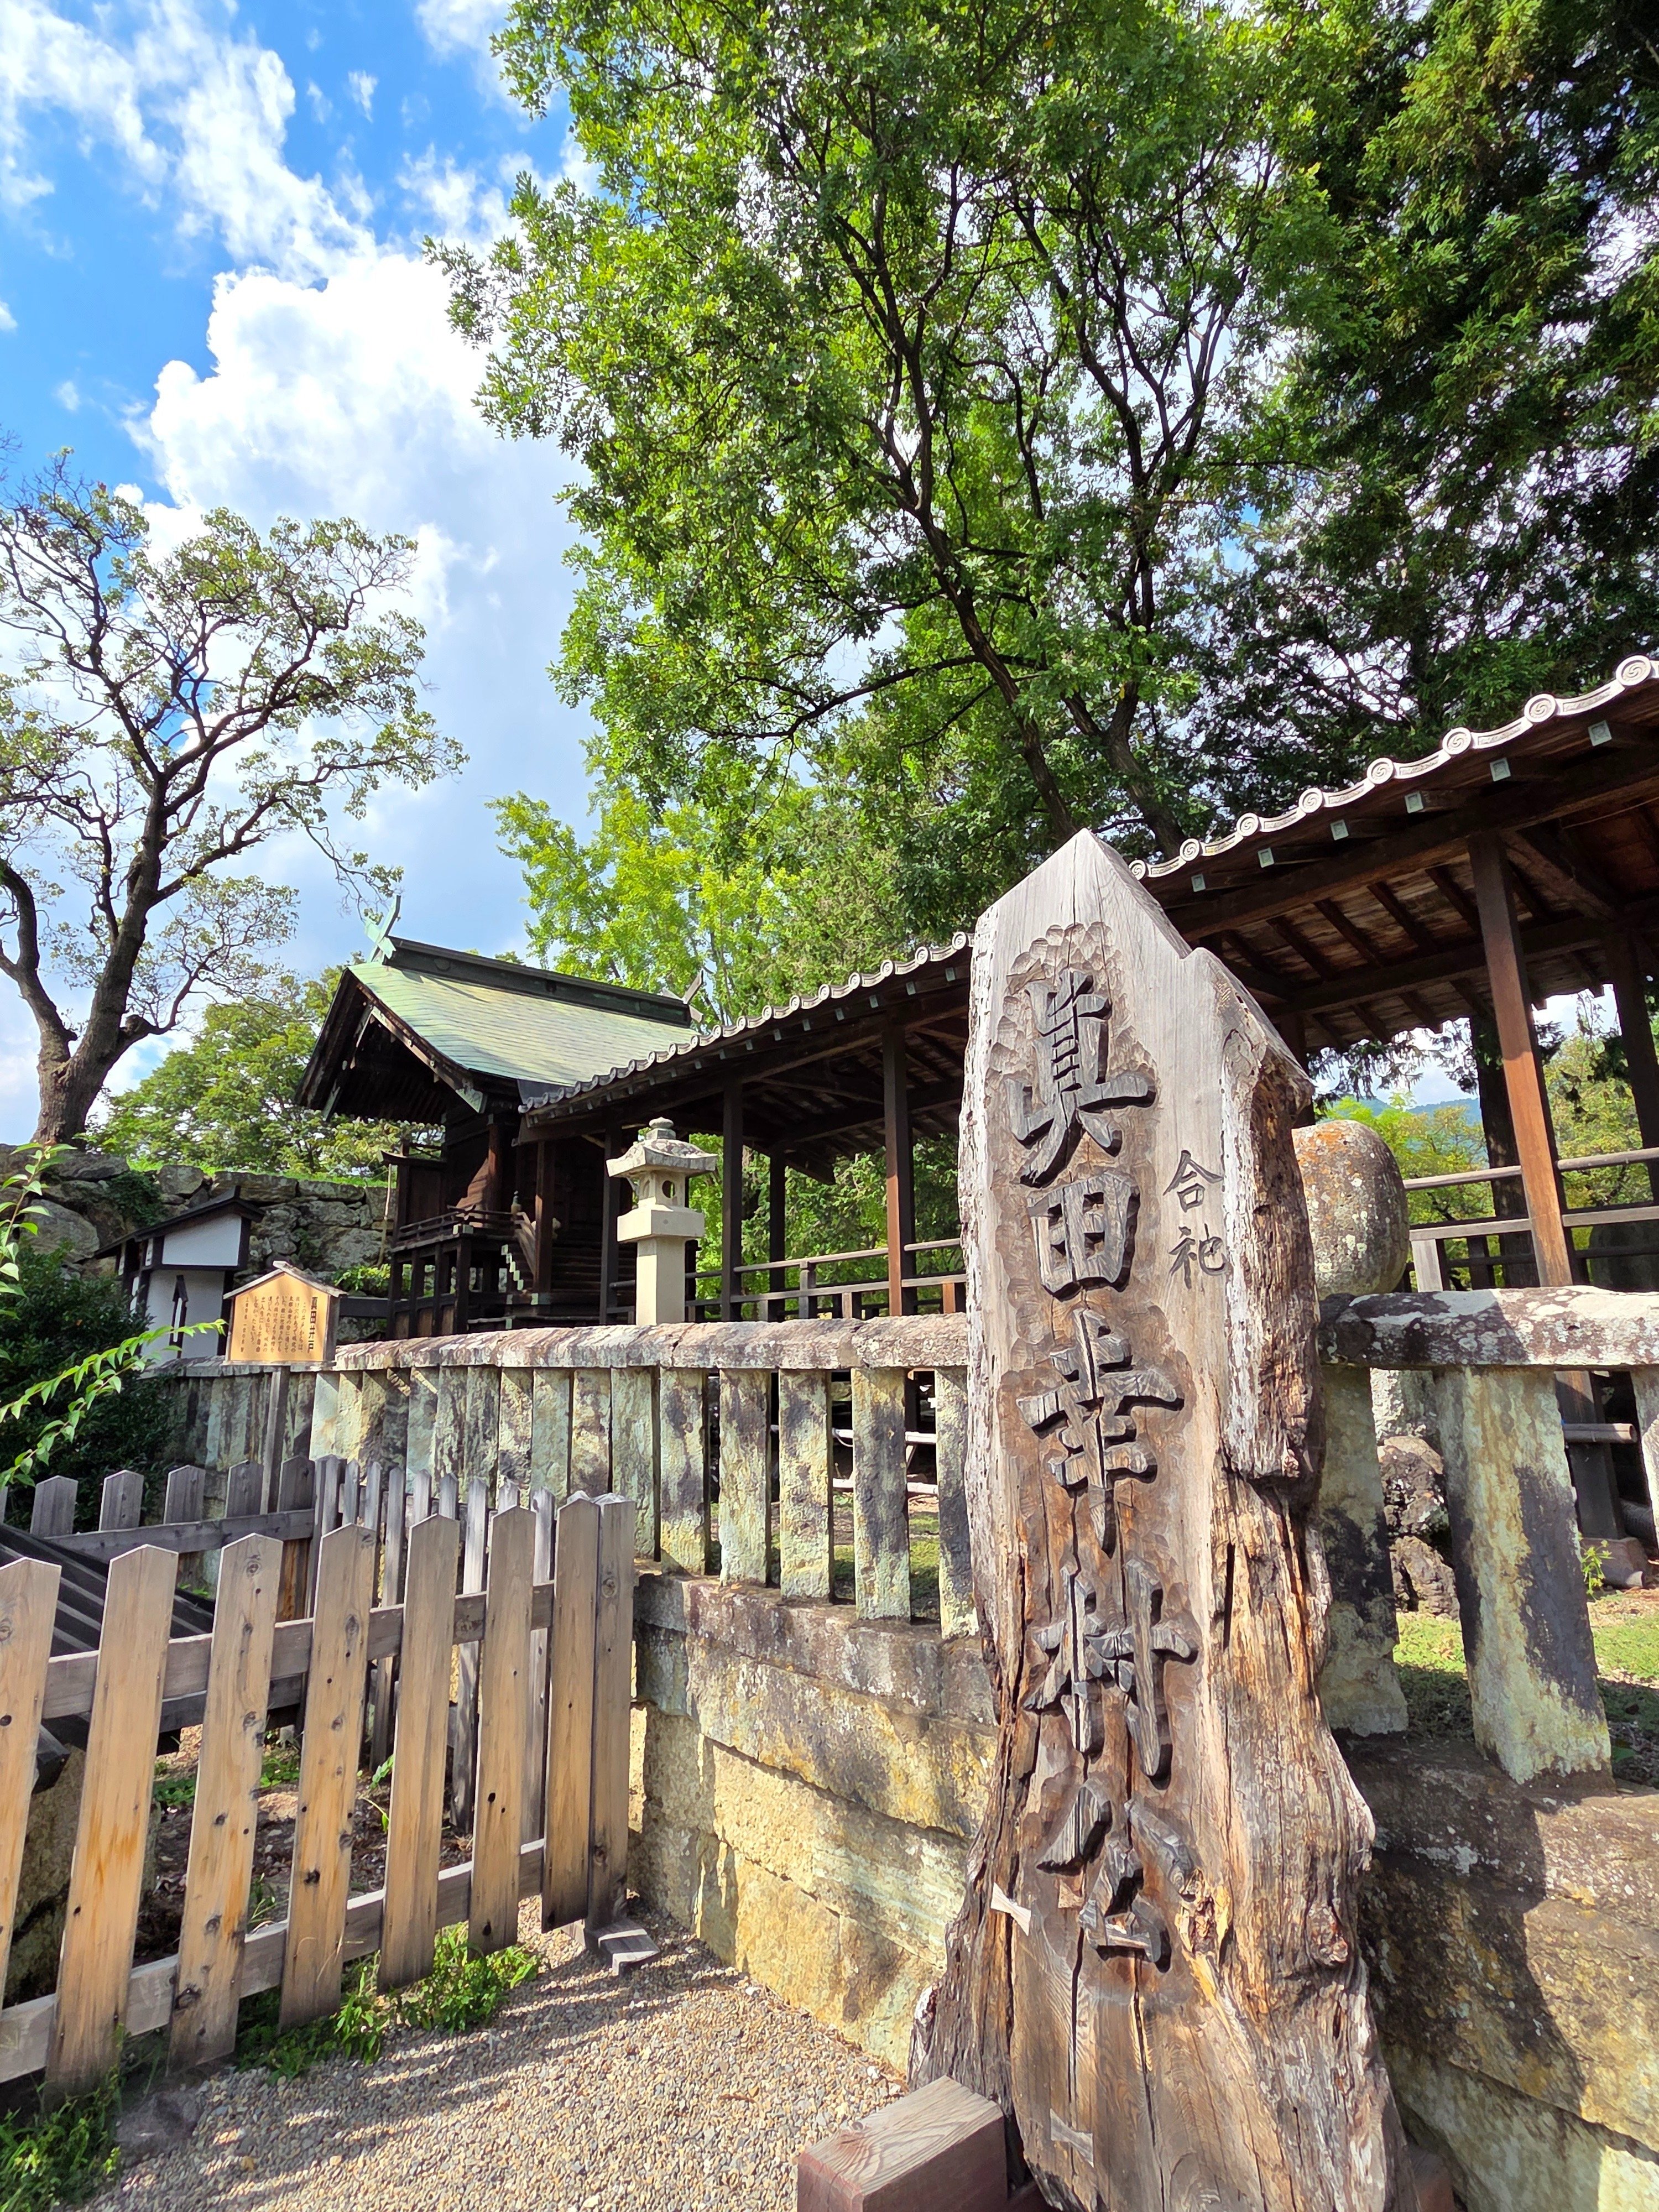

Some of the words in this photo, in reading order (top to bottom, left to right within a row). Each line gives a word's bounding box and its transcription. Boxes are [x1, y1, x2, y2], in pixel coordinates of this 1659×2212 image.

[1162, 1149, 1229, 1289] 合祀
[307, 1296, 318, 1353] 真田井戸
